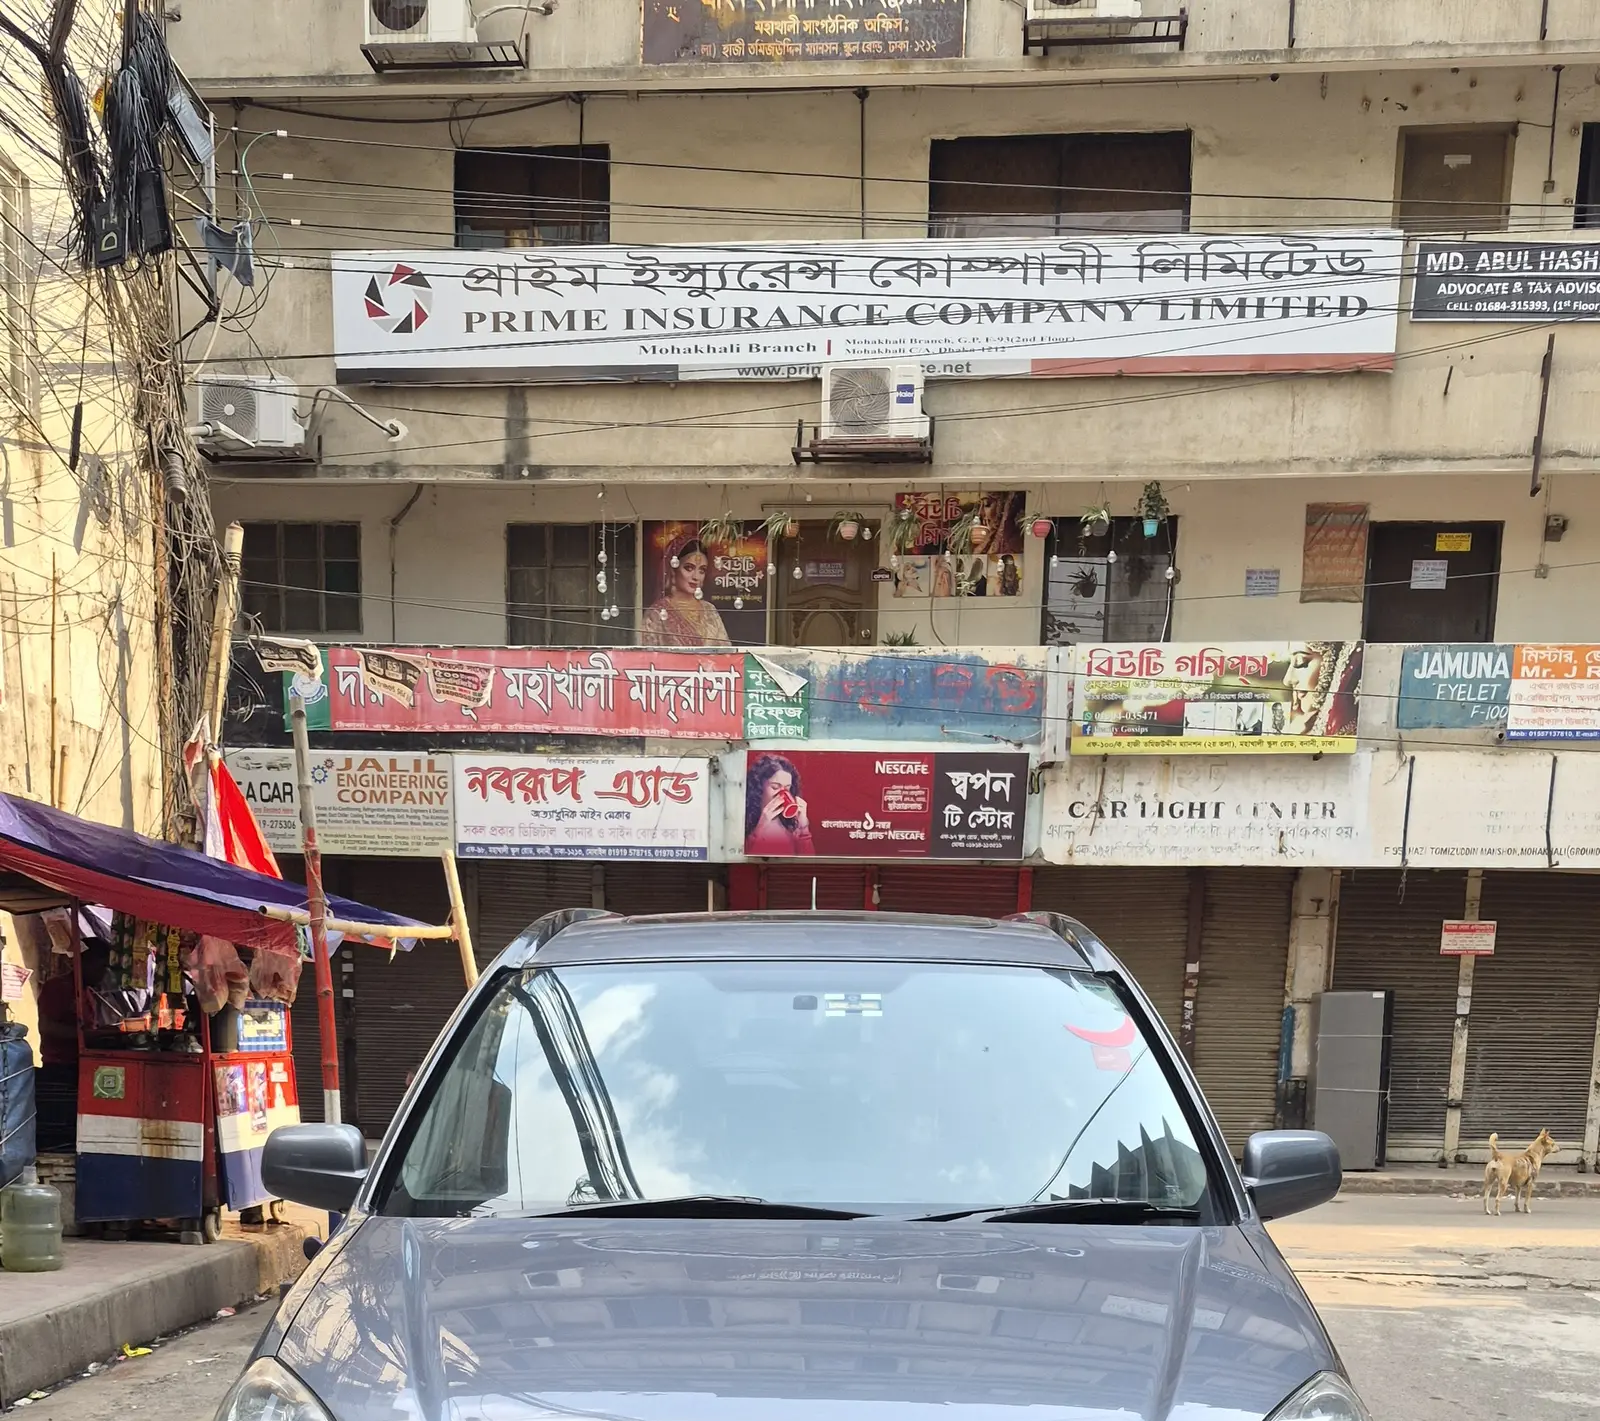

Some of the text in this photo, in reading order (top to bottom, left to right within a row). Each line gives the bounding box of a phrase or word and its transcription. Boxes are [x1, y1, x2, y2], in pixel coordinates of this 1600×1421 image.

[754, 14, 799, 36] মহাখালী
[463, 254, 607, 298] প্রাইম
[1132, 239, 1373, 283] লিমিটেড
[1426, 249, 1600, 272] MD. ABUL HASH
[1437, 282, 1509, 295] ADVOCATE
[1512, 282, 1523, 294] &
[1527, 281, 1552, 294] TAX
[462, 295, 1369, 333] PRIME INSURANCE COMPANY LIMITED
[1447, 302, 1473, 312] CELL:
[638, 342, 818, 356] Mohakhali Branch
[845, 338, 904, 346] Mohakhali
[1086, 647, 1165, 678] বিউটি
[1413, 651, 1510, 679] JAMUNA
[1520, 665, 1556, 679] Mr.
[1563, 665, 1578, 679] J
[501, 652, 619, 715] মহাখালী
[1436, 683, 1502, 701] EYELET
[1121, 725, 1149, 735] Gossips
[336, 757, 448, 773] JALIL
[336, 773, 449, 790] ENGINEERING
[464, 766, 588, 804] নবরূপ
[944, 768, 1017, 803] স্বপন
[259, 781, 294, 804] CAR
[337, 788, 449, 806] COMPANY
[942, 804, 1016, 830] টি স্টোর
[1068, 800, 1129, 819] CAR
[463, 824, 486, 838] সকল
[489, 825, 514, 838] প্রকার
[518, 824, 557, 838] ডিজিটাল
[608, 825, 633, 838] সাইন
